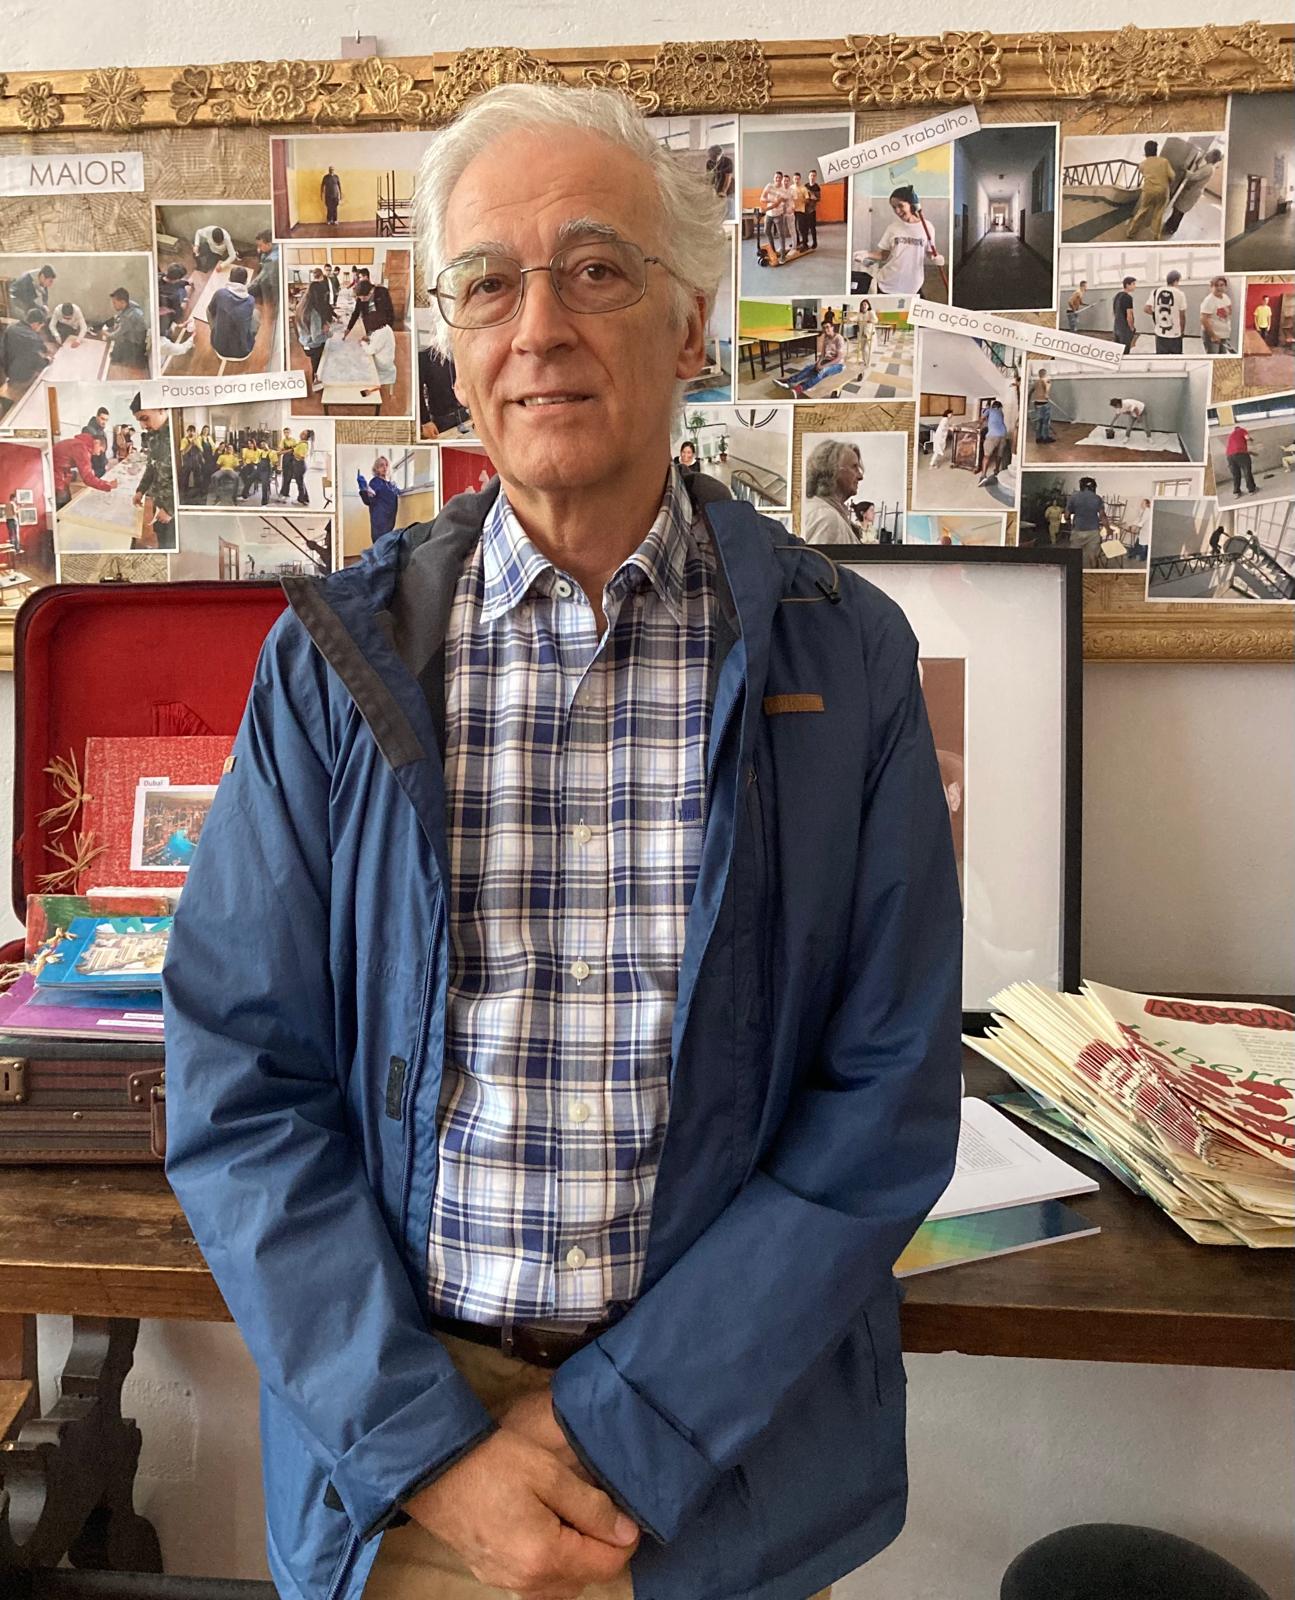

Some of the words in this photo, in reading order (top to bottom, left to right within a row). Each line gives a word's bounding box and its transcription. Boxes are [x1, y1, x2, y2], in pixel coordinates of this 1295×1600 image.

[827, 149, 878, 175] Alegria
[881, 140, 900, 155] no
[903, 114, 973, 147] Trabalho.
[30, 161, 126, 186] MAIOR
[912, 304, 934, 320] Em
[939, 314, 979, 330] ação
[983, 322, 1029, 343] com...
[1033, 332, 1121, 363] Formadores
[162, 385, 210, 397] Pausas
[214, 382, 247, 397] para
[250, 377, 305, 393] reflexão
[143, 779, 164, 787] Dubai
